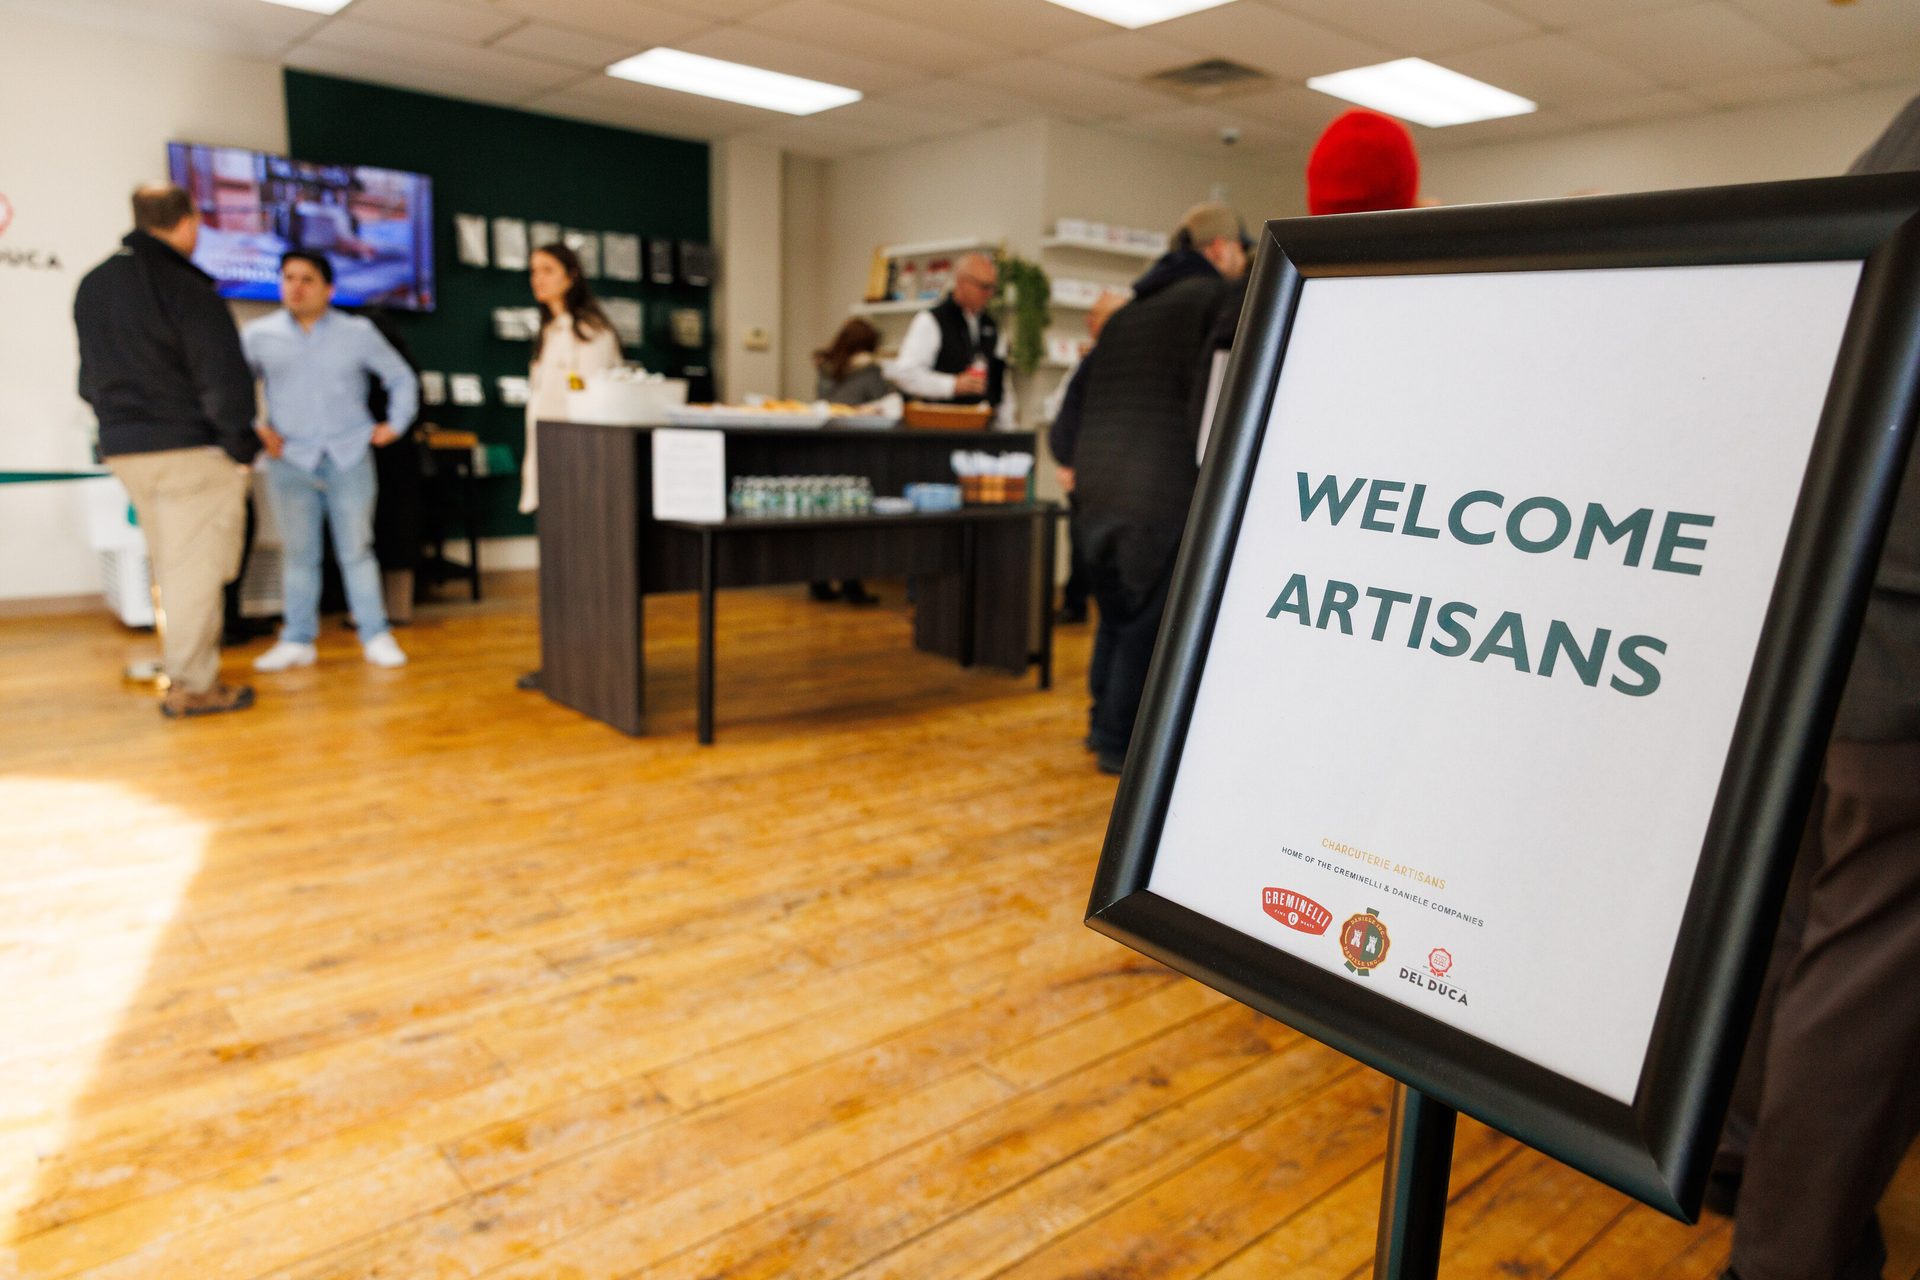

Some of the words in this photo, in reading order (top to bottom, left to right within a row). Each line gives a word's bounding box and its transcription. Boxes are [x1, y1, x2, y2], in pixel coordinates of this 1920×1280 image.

[1296, 471, 1716, 576] WELCOME
[1265, 573, 1668, 697] ARTISANS
[1281, 846, 1303, 860] HOME
[1304, 855, 1315, 864] OF
[1317, 859, 1332, 871] THE
[1333, 866, 1382, 889] CREMINELLI
[1383, 884, 1390, 893] &
[1391, 887, 1429, 907] DANIELE
[1431, 902, 1484, 928] COMPANIES
[1321, 837, 1391, 870] CHARCUTERIE
[1393, 863, 1446, 890] ARTISANS
[1265, 890, 1330, 928] CREMINELLI
[1399, 967, 1424, 987] DEL
[1427, 979, 1468, 1006] DUCA
